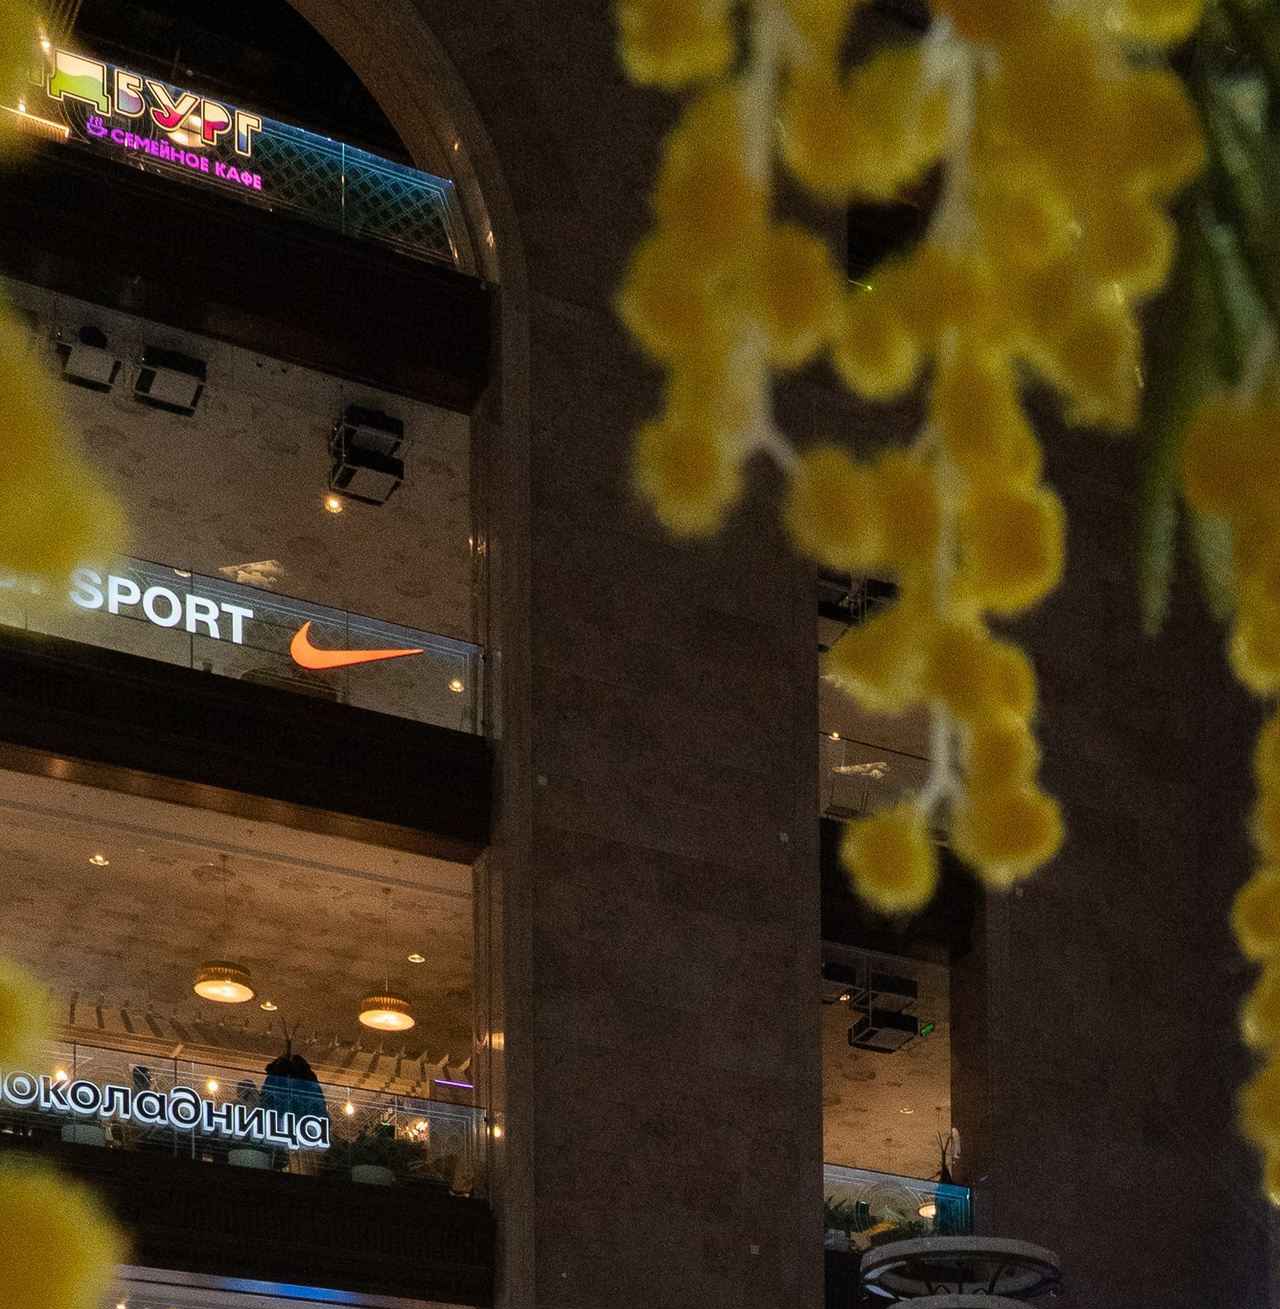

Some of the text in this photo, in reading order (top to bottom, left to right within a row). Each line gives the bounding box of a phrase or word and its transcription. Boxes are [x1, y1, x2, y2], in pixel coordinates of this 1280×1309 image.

[110, 127, 262, 191] СЕМЕЙНОЕ КАФЕ
[69, 567, 254, 644] SPORT
